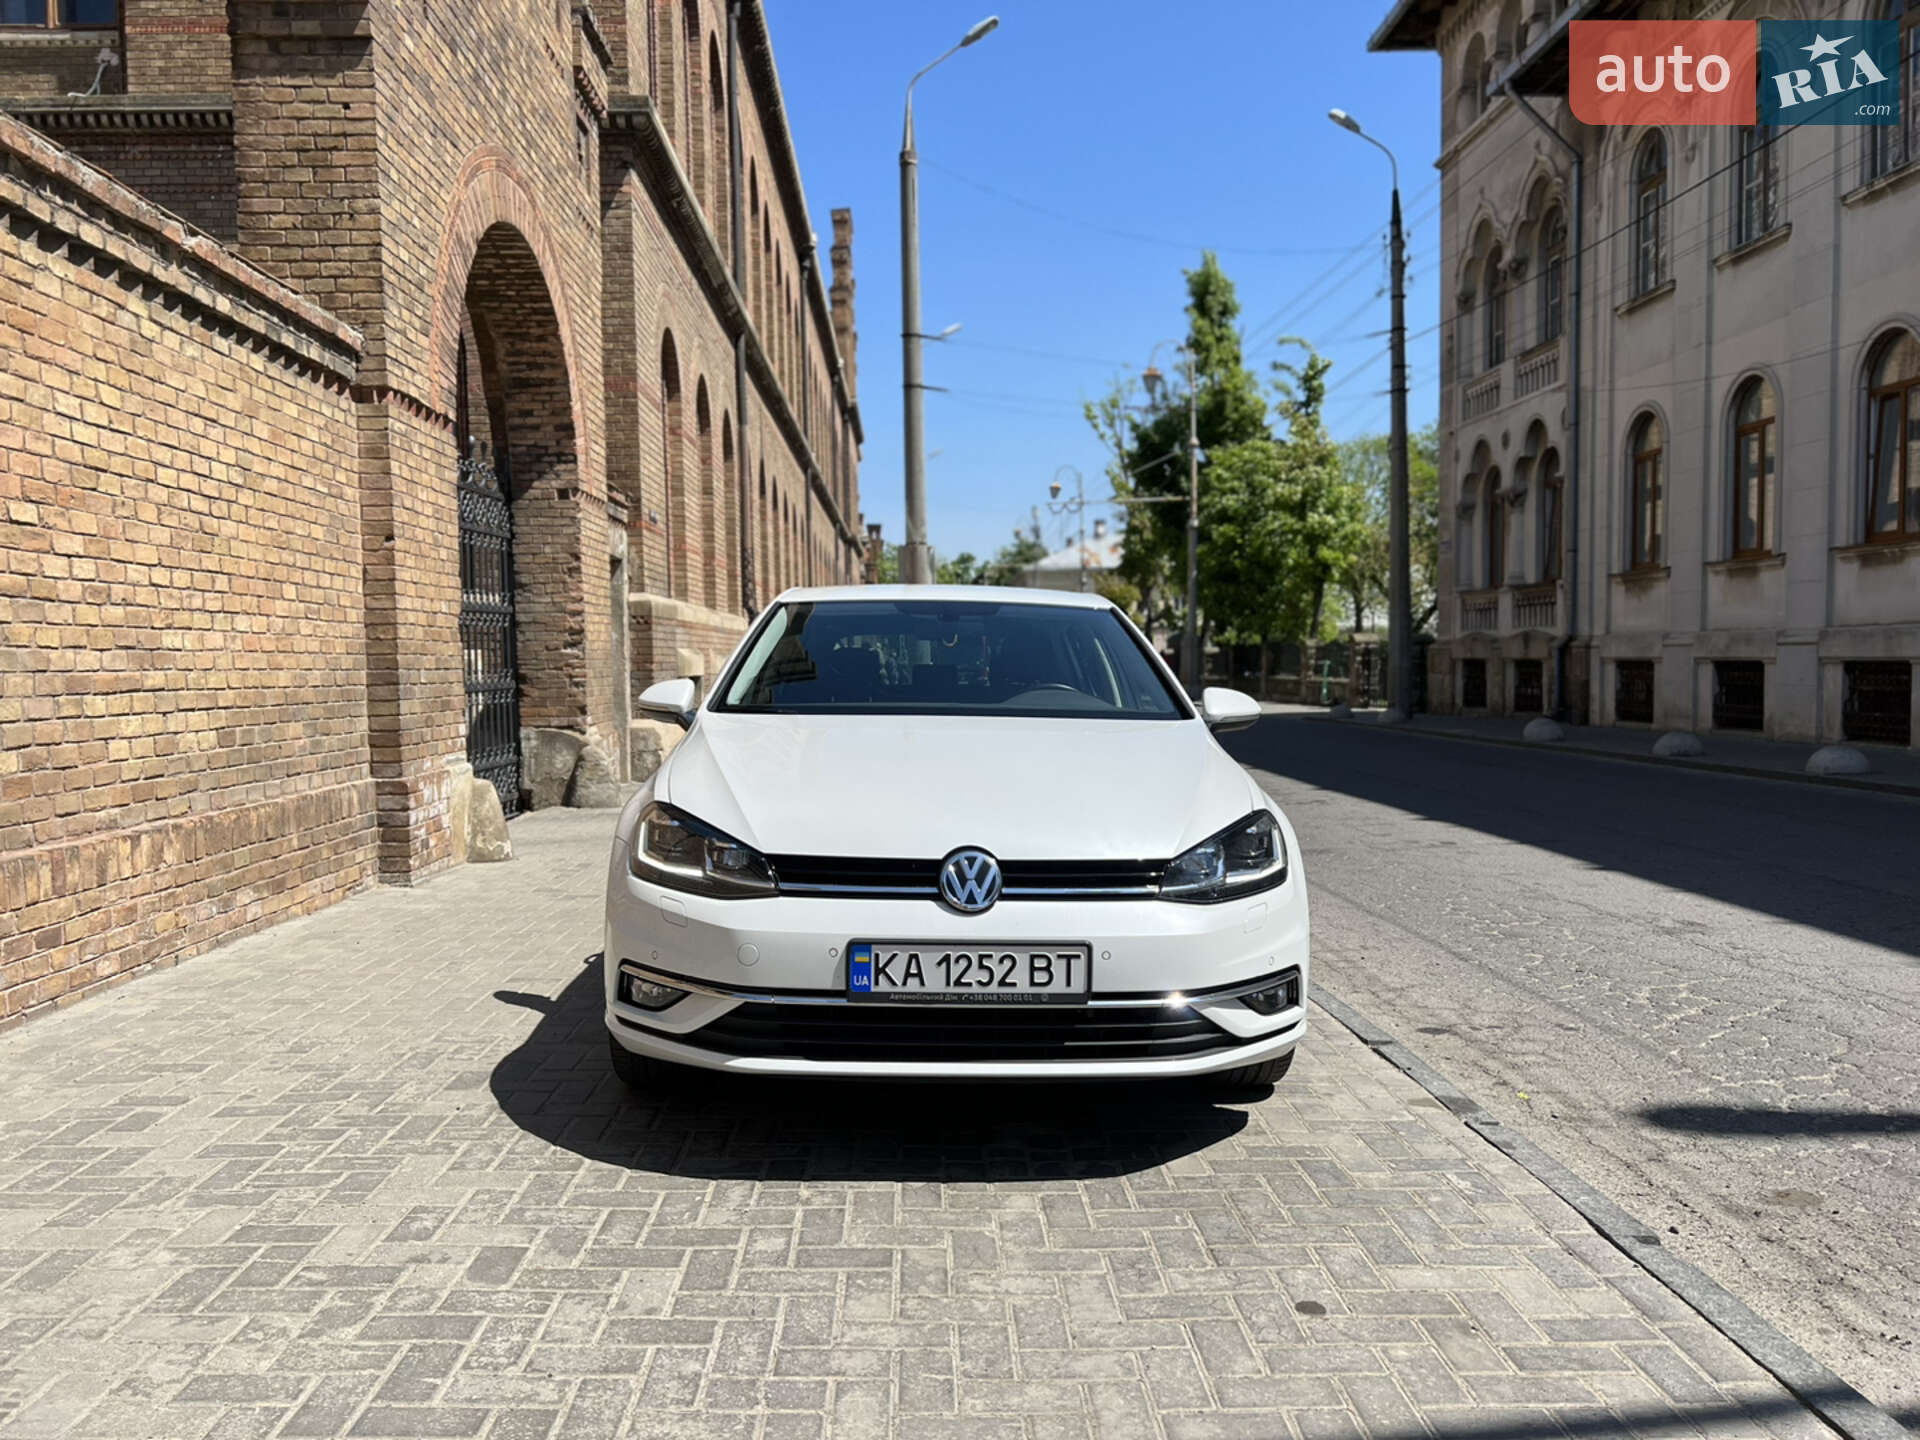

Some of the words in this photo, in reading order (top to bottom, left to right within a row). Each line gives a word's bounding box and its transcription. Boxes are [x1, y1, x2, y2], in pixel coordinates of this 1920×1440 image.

[853, 975, 869, 987] UA
[873, 952, 926, 988] KA
[936, 952, 1018, 988] 1252
[1028, 952, 1082, 988] BT
